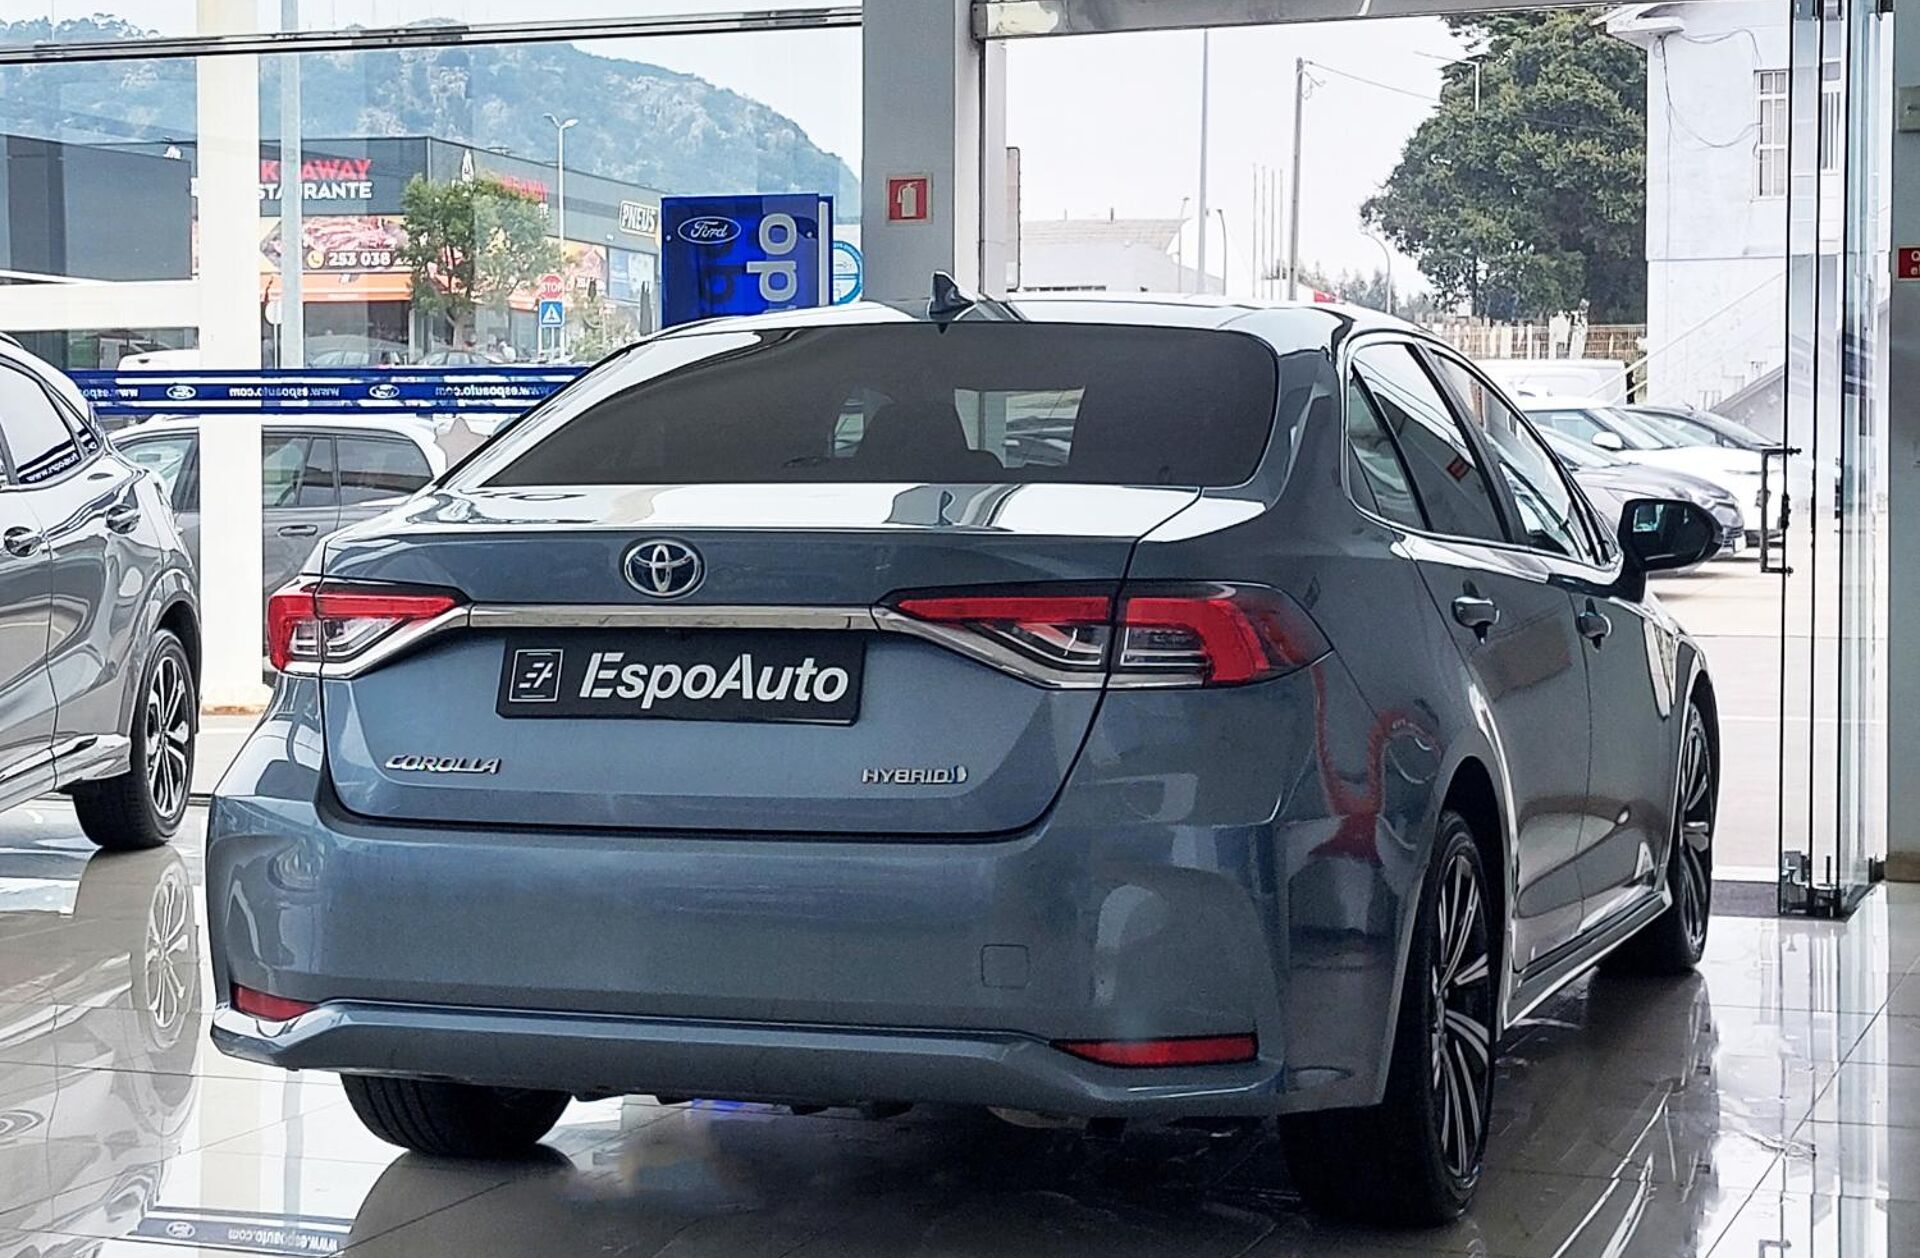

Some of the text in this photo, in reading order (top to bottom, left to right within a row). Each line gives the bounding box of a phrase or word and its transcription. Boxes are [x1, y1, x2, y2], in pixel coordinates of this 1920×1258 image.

[622, 204, 655, 232] PNEUS
[690, 220, 728, 239] Ford
[542, 282, 564, 293] STOP
[579, 652, 849, 709] EspoAuto
[385, 755, 501, 775] COROLLA
[862, 768, 955, 784] HYBRID
